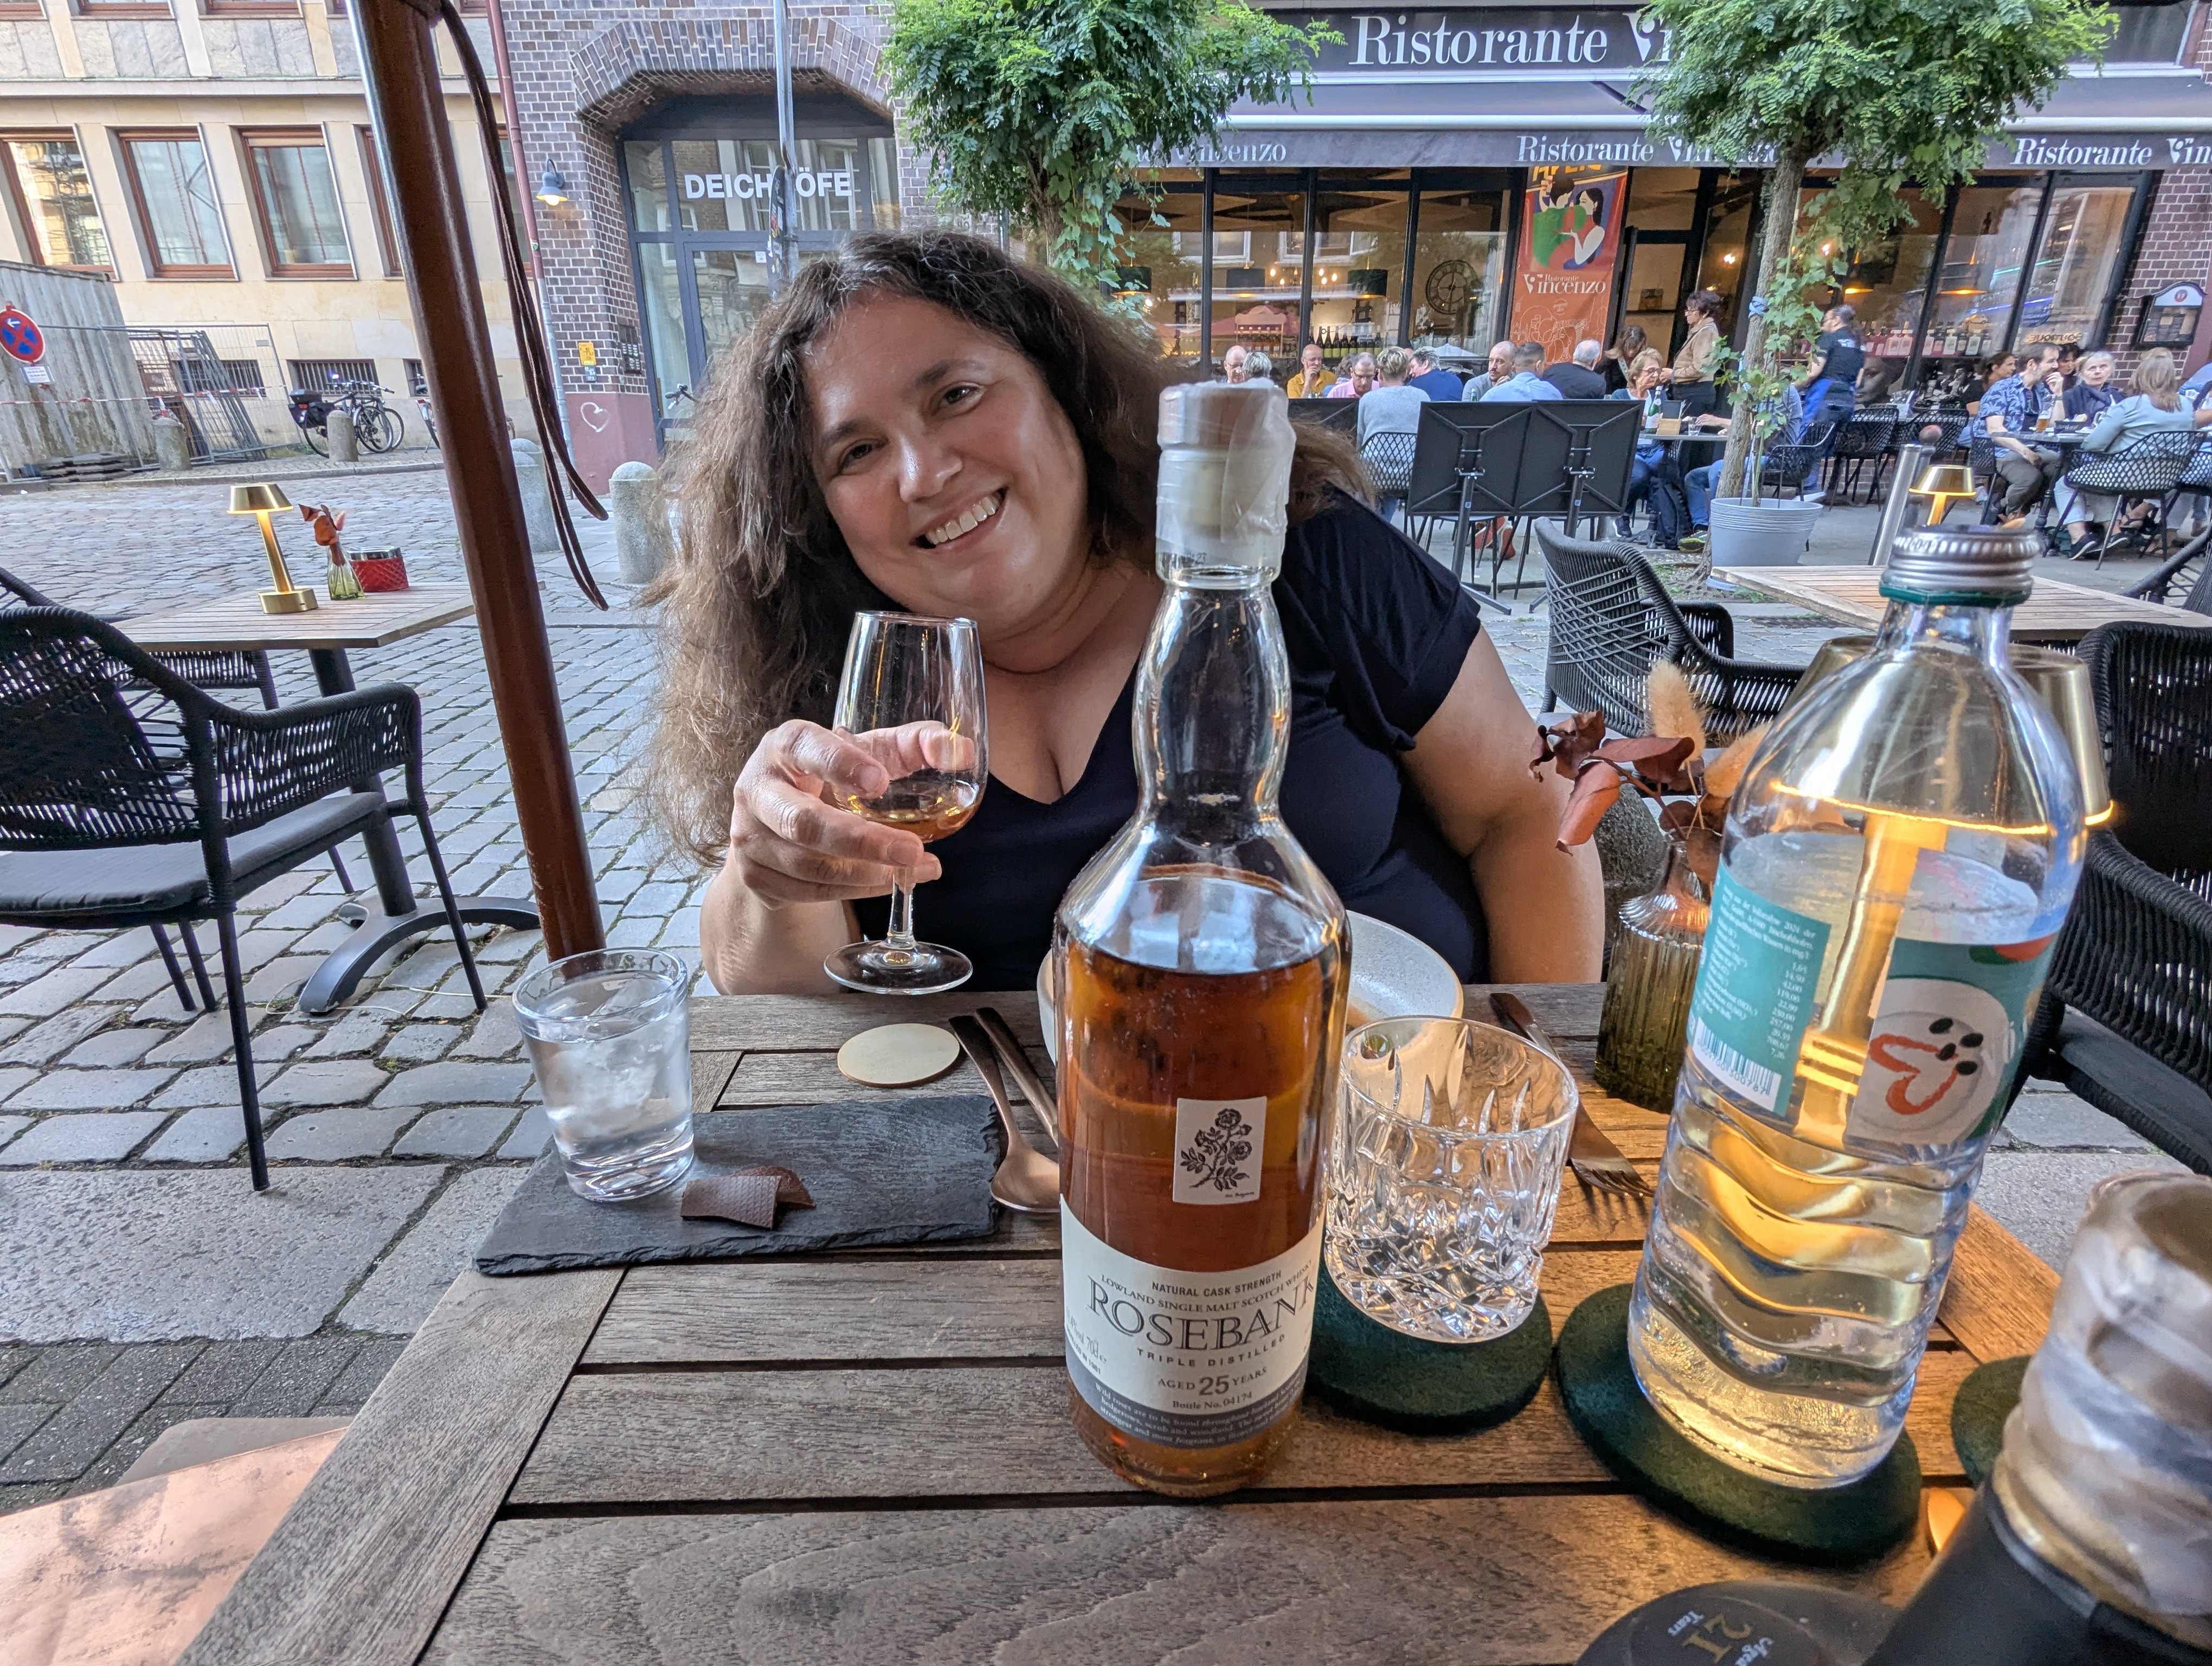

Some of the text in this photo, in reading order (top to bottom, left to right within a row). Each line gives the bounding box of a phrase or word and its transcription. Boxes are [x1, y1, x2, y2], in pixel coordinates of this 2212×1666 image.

[1348, 14, 1608, 65] Ristorante
[1517, 136, 1654, 163] Ristorante
[2010, 138, 2212, 165] Ristorante Vin
[684, 167, 852, 199] DEICHÖFE
[1523, 273, 1606, 294] Vincenzo
[1101, 1274, 1155, 1305] LOWLAND
[1158, 1298, 1203, 1313] SINGLE
[1205, 1302, 1239, 1313] MALT
[1240, 1283, 1284, 1307] SCOTCH
[1152, 1270, 1282, 1297] NATURAL CASK STRENGTH
[1086, 1274, 1315, 1351] ROSEBANK
[1137, 1347, 1197, 1367] TRIPLE
[1207, 1333, 1285, 1367] DISTILLED
[1088, 1359, 1102, 1375] 1981
[1095, 1382, 1111, 1400] Wild
[1158, 1378, 1195, 1391] AGED
[1198, 1374, 1230, 1396] 25
[1232, 1366, 1267, 1386] YEARS
[1172, 1399, 1202, 1410] Bottle
[1134, 1426, 1150, 1437] and
[1682, 1613, 1752, 1664] 21
